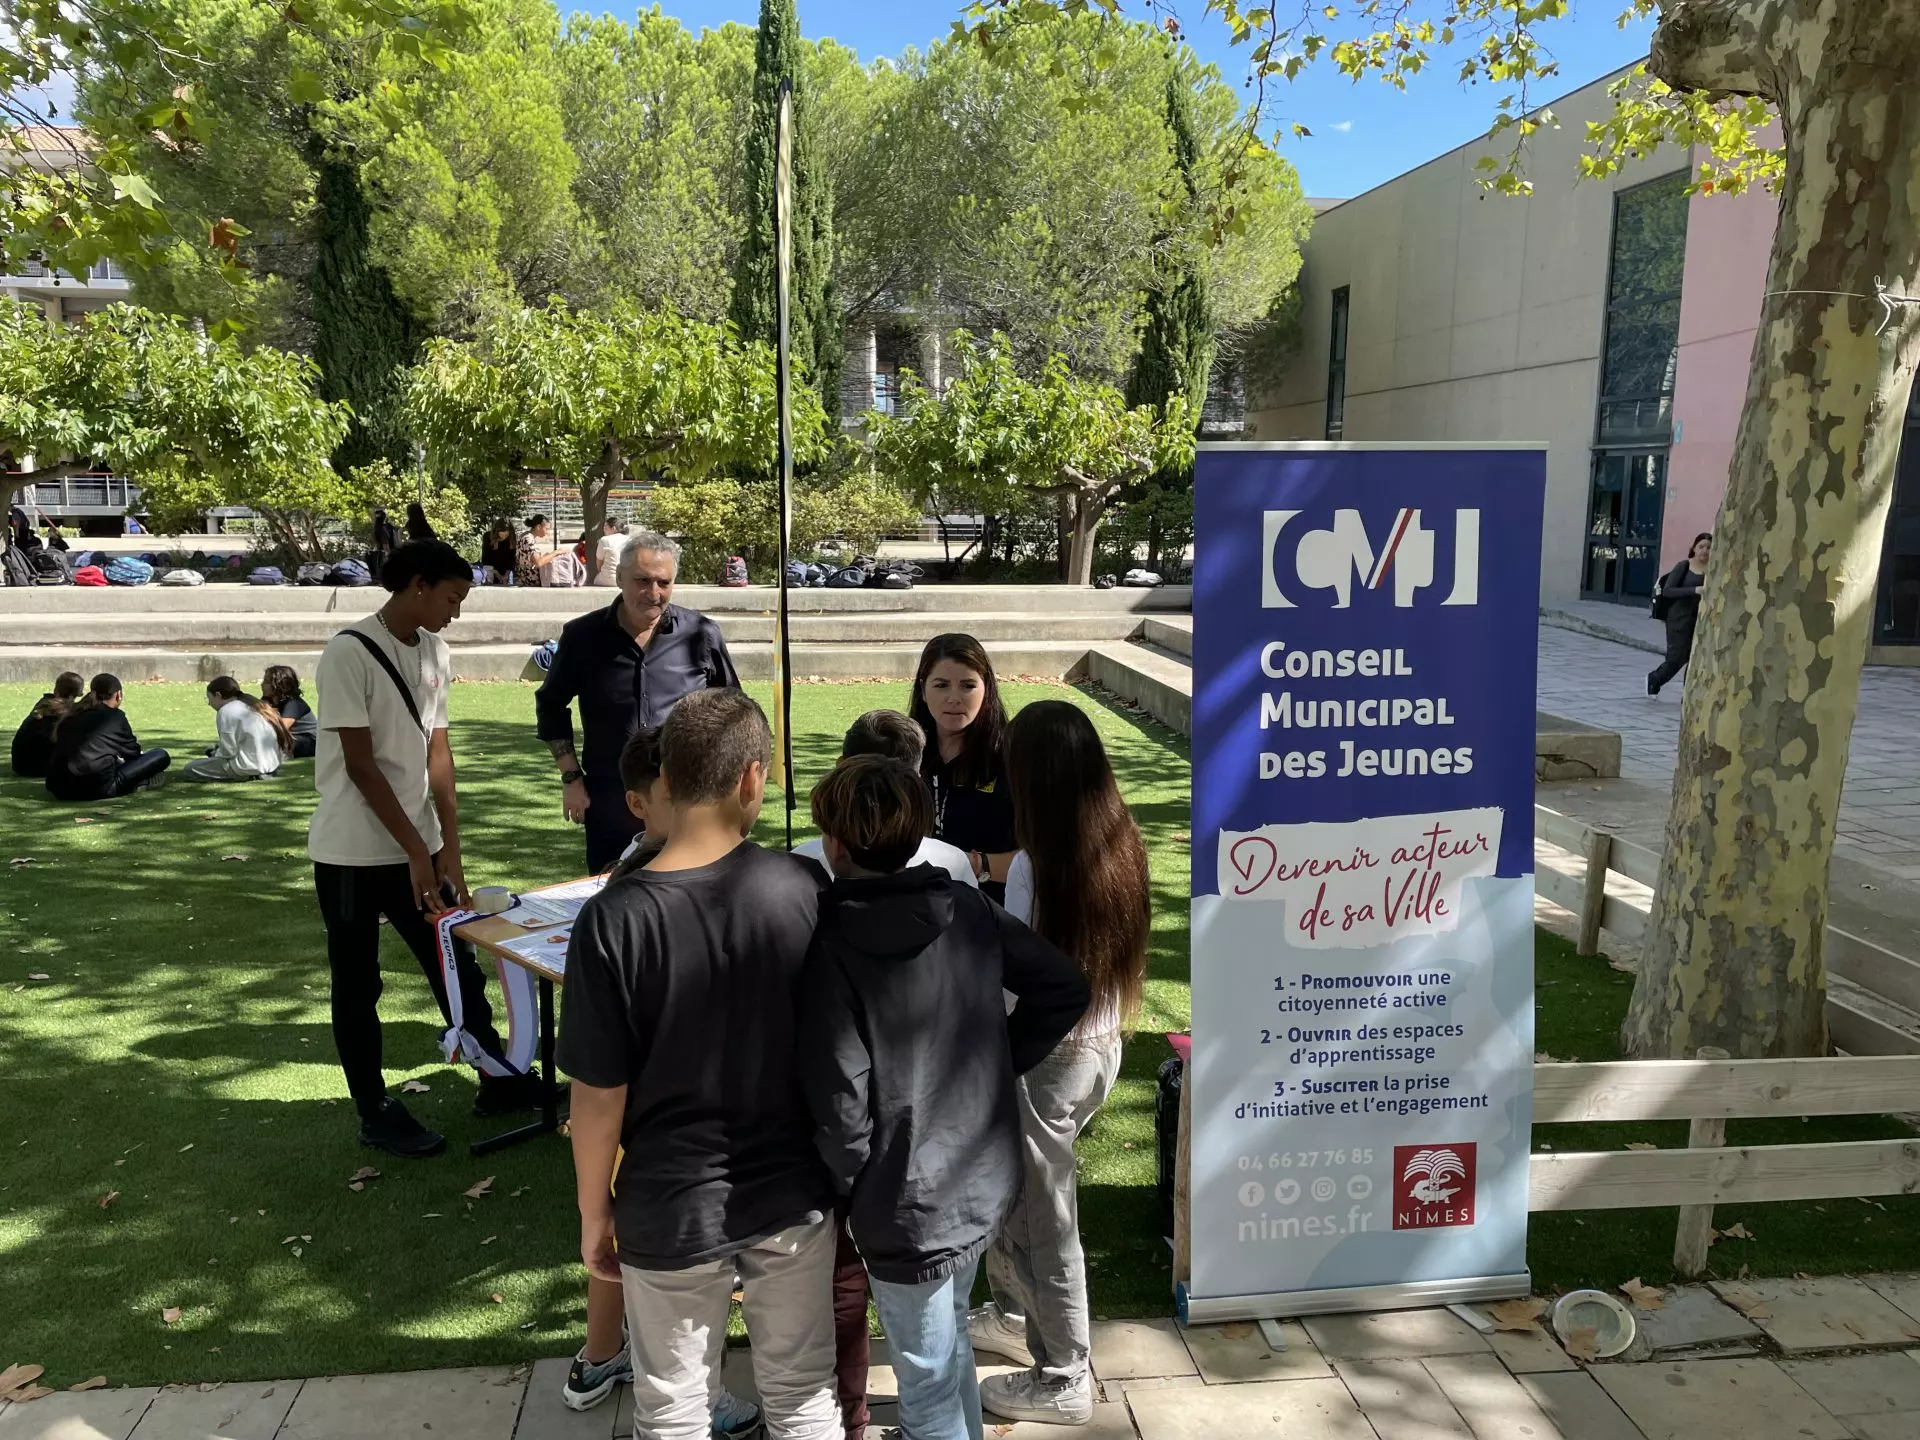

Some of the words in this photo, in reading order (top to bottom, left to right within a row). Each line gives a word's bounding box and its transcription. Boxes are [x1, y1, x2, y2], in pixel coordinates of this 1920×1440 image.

[1261, 507, 1480, 608] CMJ
[1337, 740, 1473, 778] Jeunes
[1229, 835, 1379, 896] Devenir
[1390, 821, 1490, 872] acteur
[1299, 882, 1334, 940] de
[1341, 900, 1375, 932] sa
[1384, 867, 1450, 928] Ville
[1273, 976, 1285, 991] 1
[1418, 973, 1451, 986] une
[1278, 992, 1388, 1016] citoyenneté
[1392, 992, 1448, 1009] active
[1260, 1029, 1271, 1044] 2
[1357, 1024, 1388, 1041] des
[1393, 1022, 1464, 1043] espaces
[1290, 1044, 1436, 1067] d'apprentissage
[1274, 1081, 1285, 1097] 3
[1384, 1076, 1401, 1091] la
[1405, 1074, 1450, 1094] prise
[1235, 1100, 1335, 1119] d'initiative
[1340, 1098, 1358, 1113] et
[1364, 1092, 1488, 1116] l'engagement
[1238, 1155, 1264, 1171] 04
[1268, 1152, 1292, 1168] 66
[1297, 1151, 1319, 1167] 27
[1324, 1149, 1346, 1166] 76
[1351, 1148, 1373, 1165] 85
[1238, 1205, 1373, 1242] nimes.fr
[1399, 1206, 1469, 1225] NÎMES
